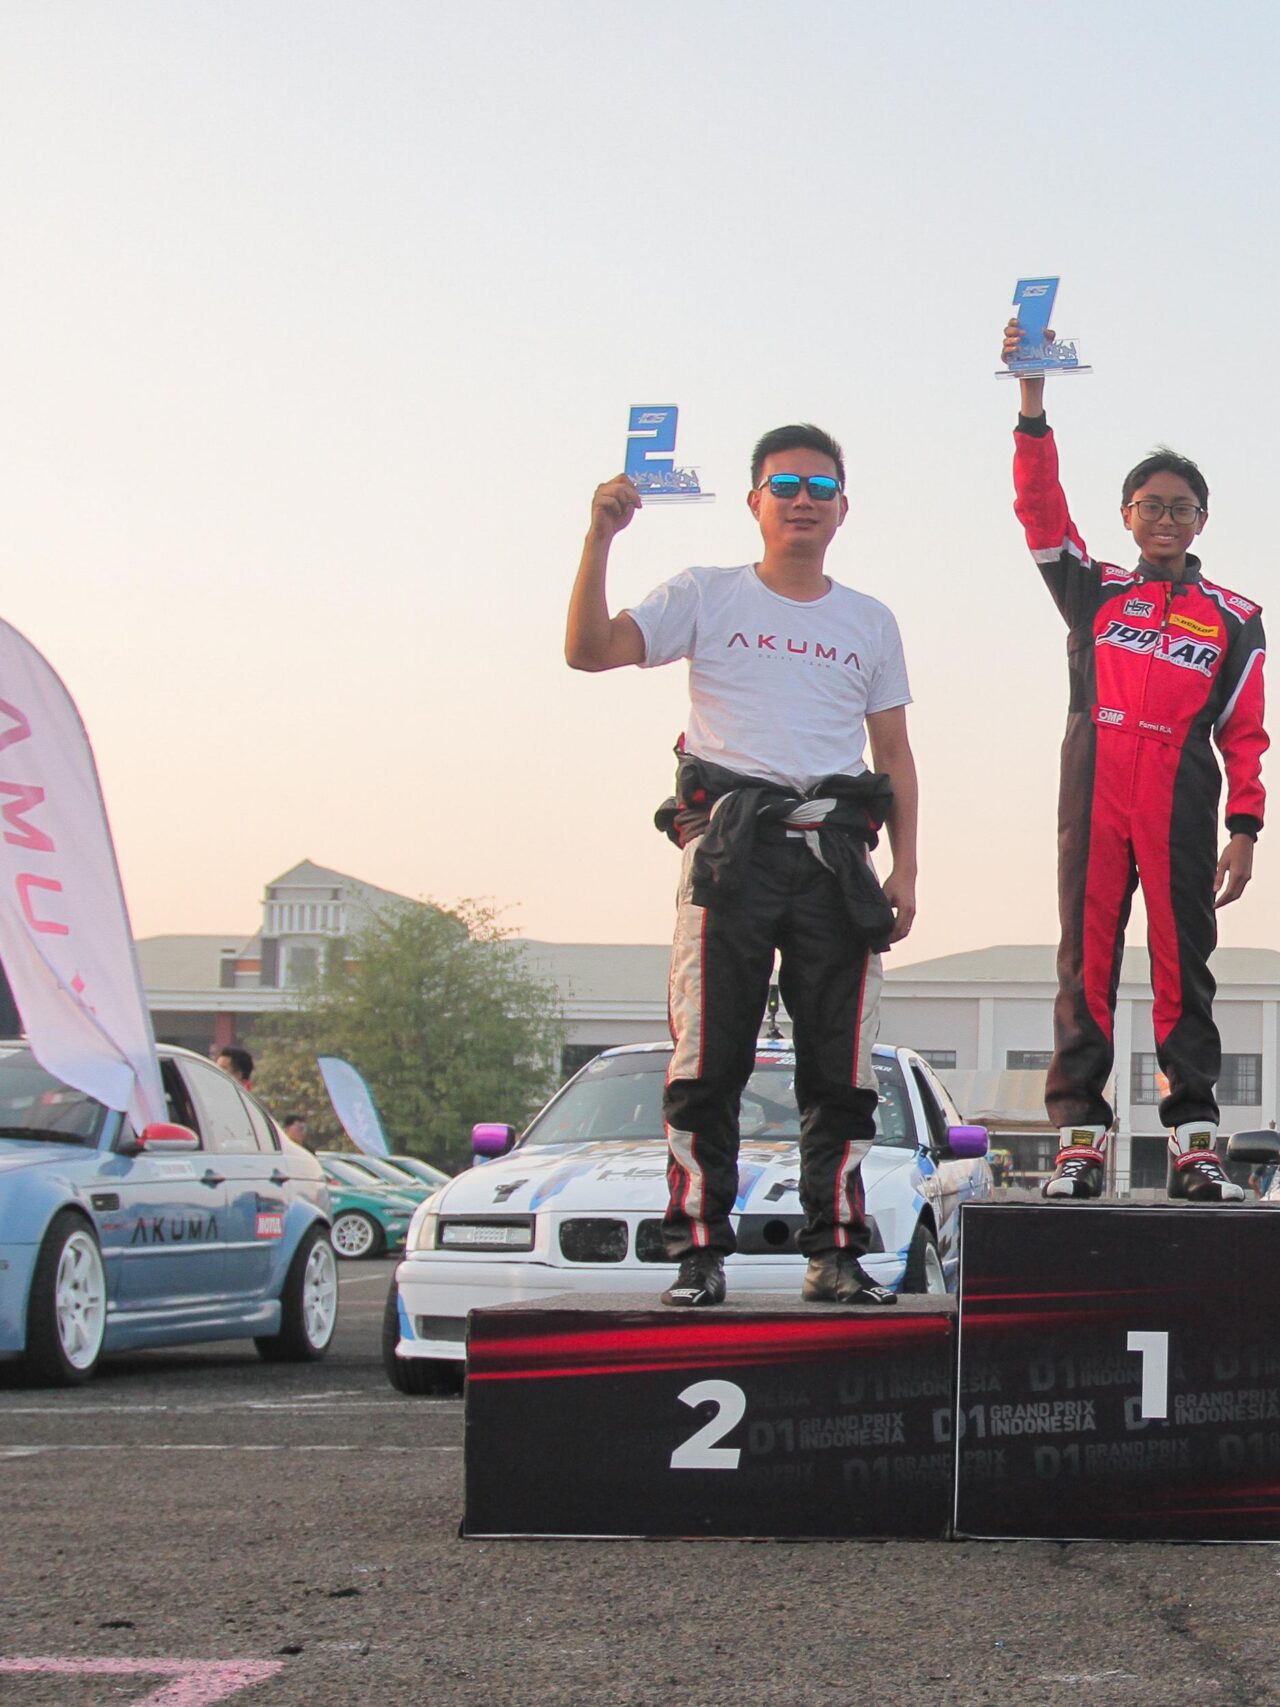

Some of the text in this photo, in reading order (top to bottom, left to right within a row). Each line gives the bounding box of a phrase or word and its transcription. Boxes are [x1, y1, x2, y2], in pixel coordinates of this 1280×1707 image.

[1180, 620, 1214, 633] DUNLOP
[727, 632, 861, 670] AKUMA
[1098, 709, 1125, 723] OMP
[131, 1215, 219, 1244] AKUMA
[257, 1216, 282, 1234] MOTUL
[1127, 1331, 1169, 1419] 1
[1174, 1388, 1280, 1409] GRAND PRIX
[990, 1399, 1097, 1420] GRAND PRIX
[669, 1379, 747, 1470] 2
[799, 1411, 905, 1432] GRAND PRIX
[990, 1415, 1098, 1437] INDONESIA
[799, 1427, 906, 1451] INDONESIA
